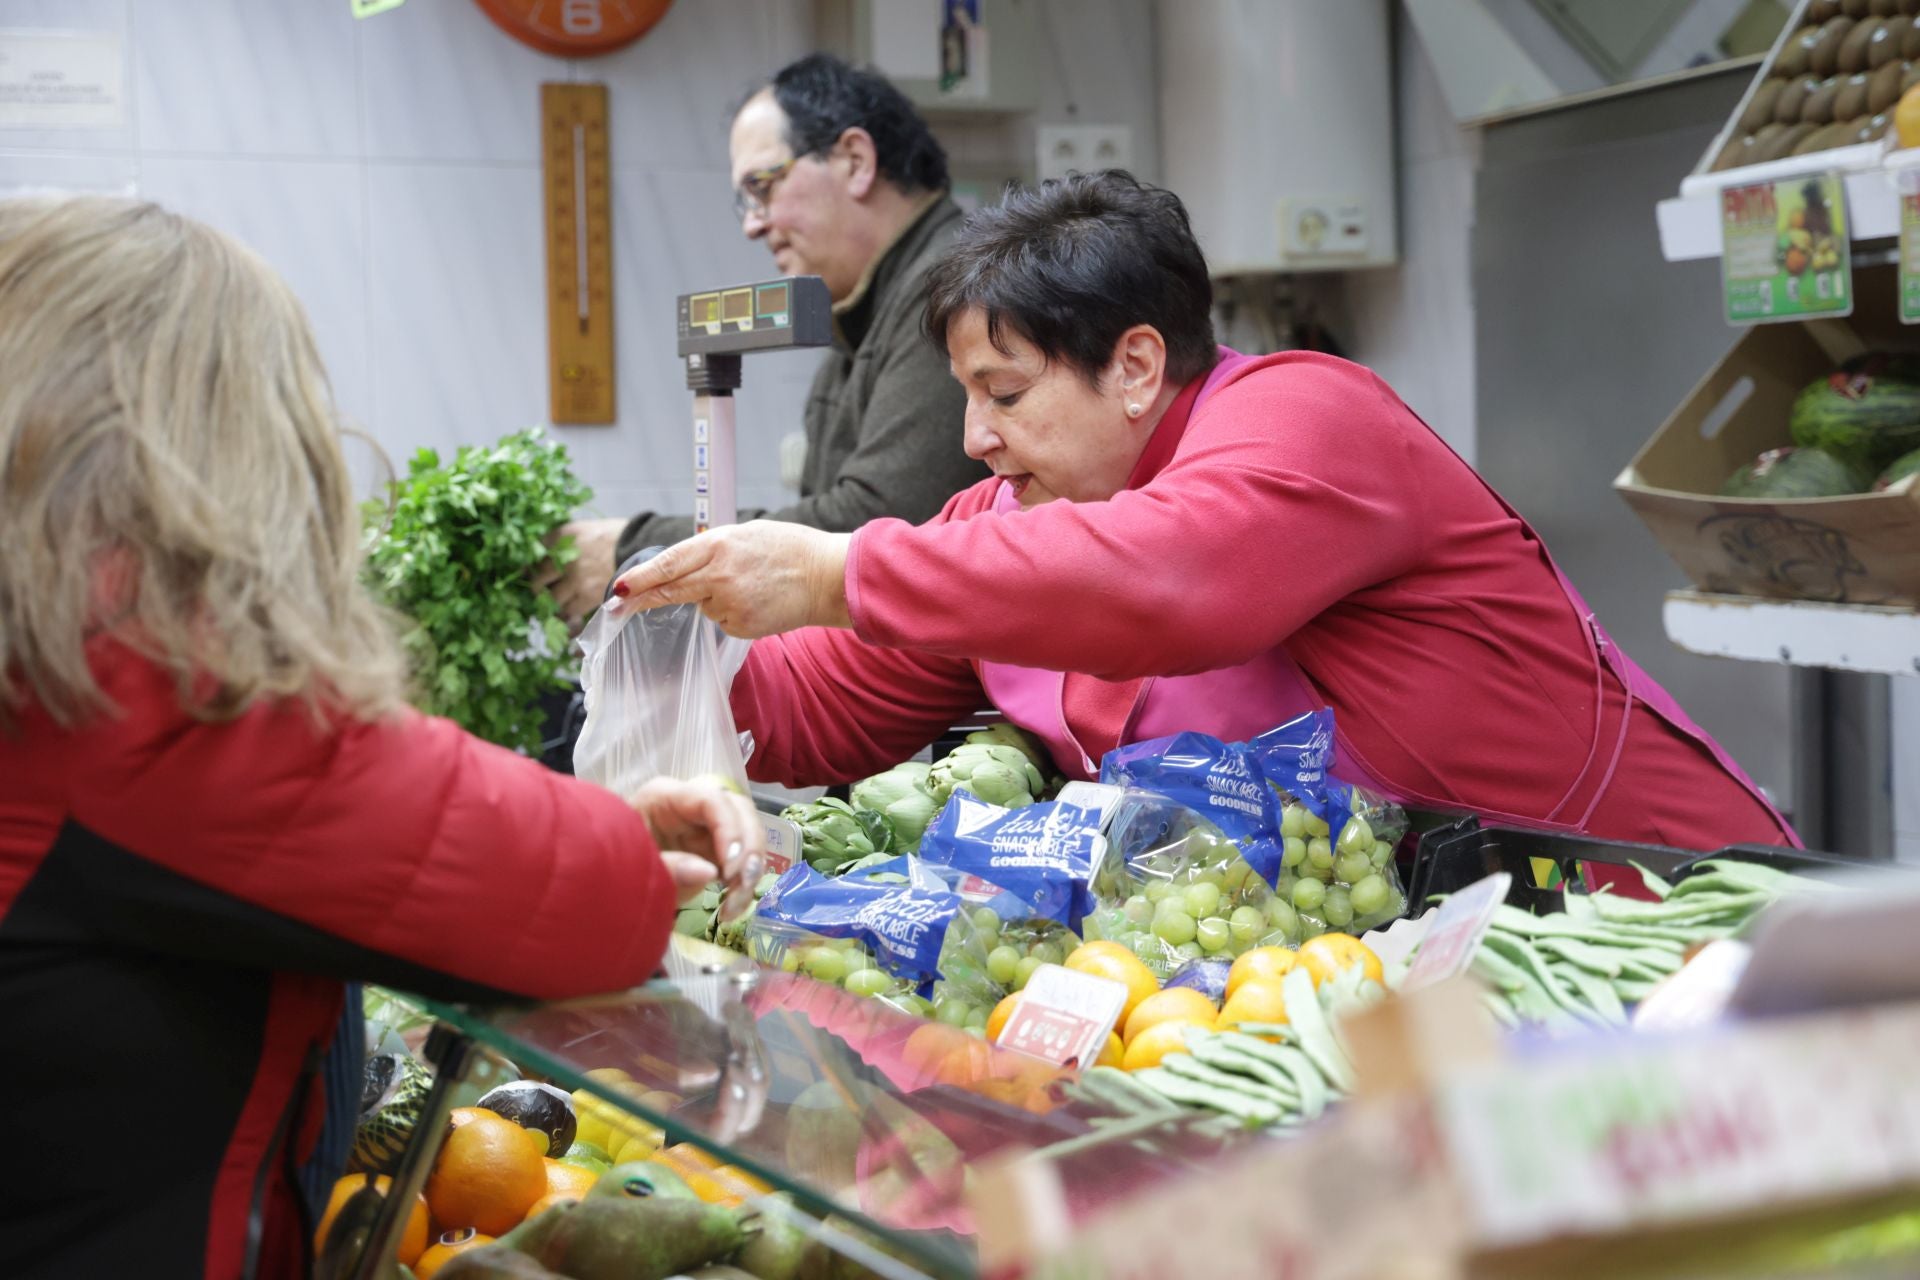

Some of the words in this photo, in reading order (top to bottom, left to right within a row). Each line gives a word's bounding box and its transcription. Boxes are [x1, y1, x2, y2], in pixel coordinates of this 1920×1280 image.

[1206, 775, 1265, 803] SNACKABLE
[1209, 795, 1263, 817] GOODNESS
[990, 835, 1072, 860] SNACKABLE
